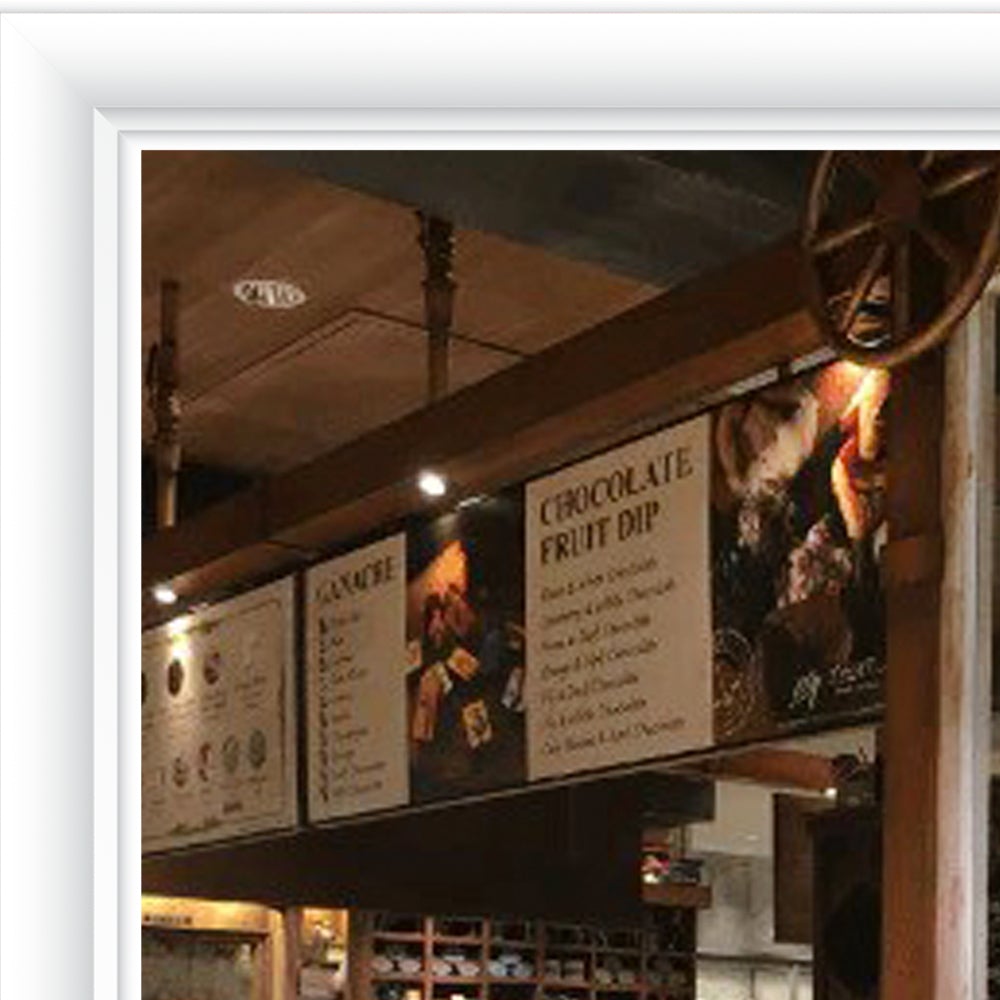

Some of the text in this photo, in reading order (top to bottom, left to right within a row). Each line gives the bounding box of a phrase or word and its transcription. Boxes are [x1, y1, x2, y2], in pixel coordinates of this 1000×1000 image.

[540, 446, 694, 527] CHOCOLATE
[540, 500, 661, 566] FRUIT DIP
